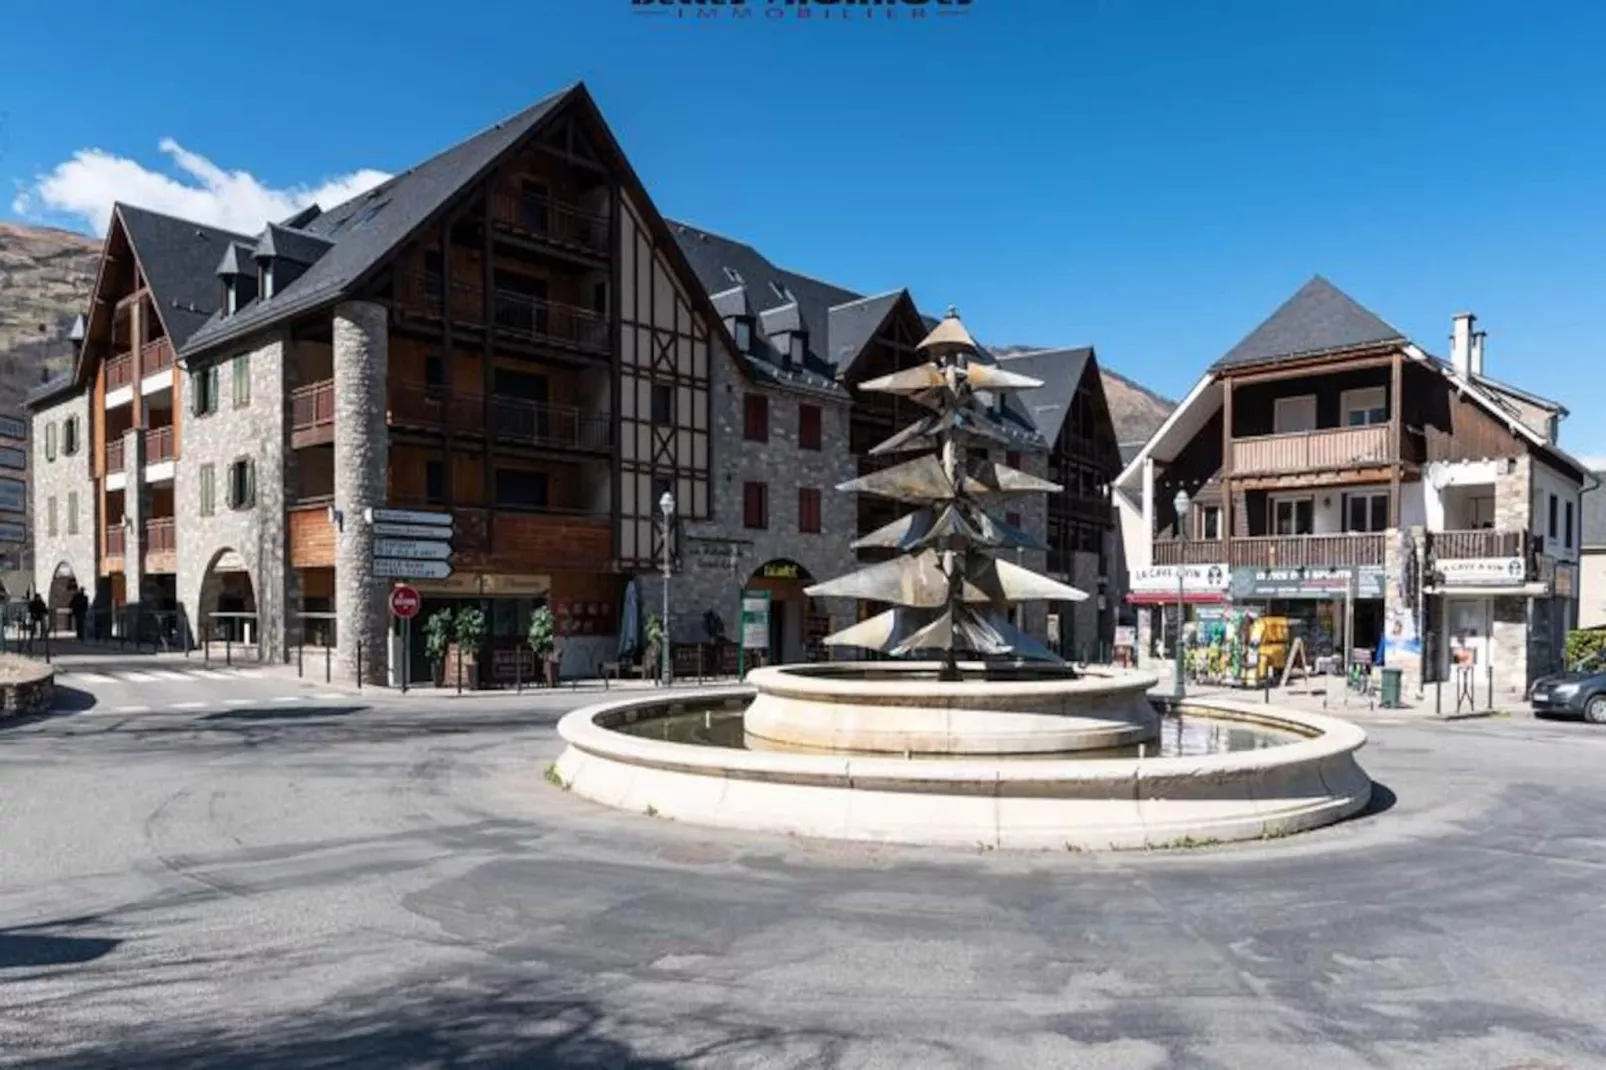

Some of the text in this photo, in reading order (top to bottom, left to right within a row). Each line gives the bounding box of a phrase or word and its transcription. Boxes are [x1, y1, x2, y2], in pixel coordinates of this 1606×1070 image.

[1450, 563, 1475, 572] CAVE
[1135, 569, 1148, 581] LA
[1149, 567, 1171, 578] CAVE
